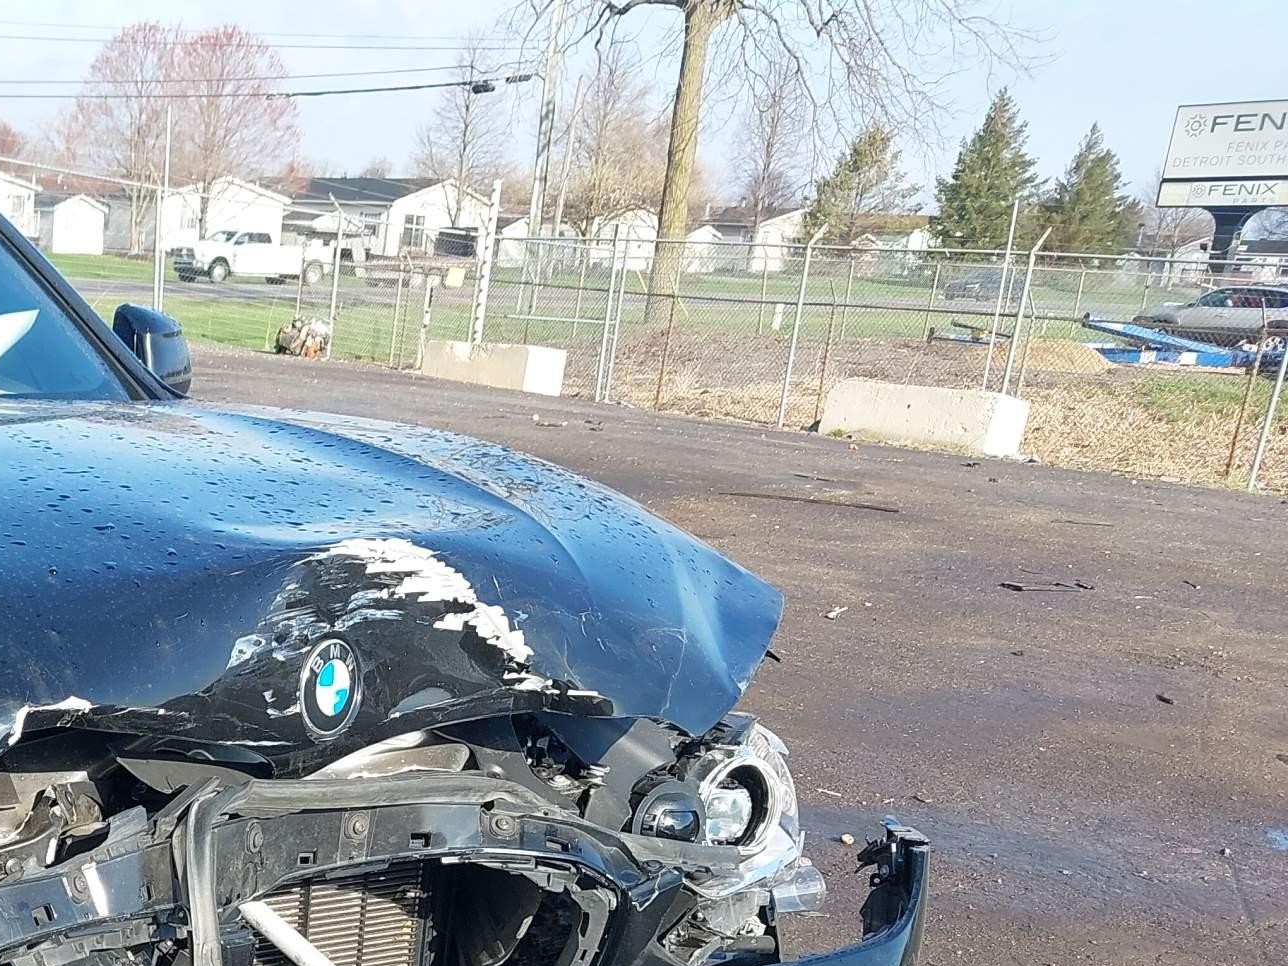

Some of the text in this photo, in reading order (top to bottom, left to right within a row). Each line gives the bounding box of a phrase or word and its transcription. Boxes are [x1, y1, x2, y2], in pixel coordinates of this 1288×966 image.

[1226, 141, 1270, 152] FENIX
[1173, 156, 1233, 168] DETROIT
[1208, 183, 1279, 196] FENIX
[311, 644, 355, 673] BMW
